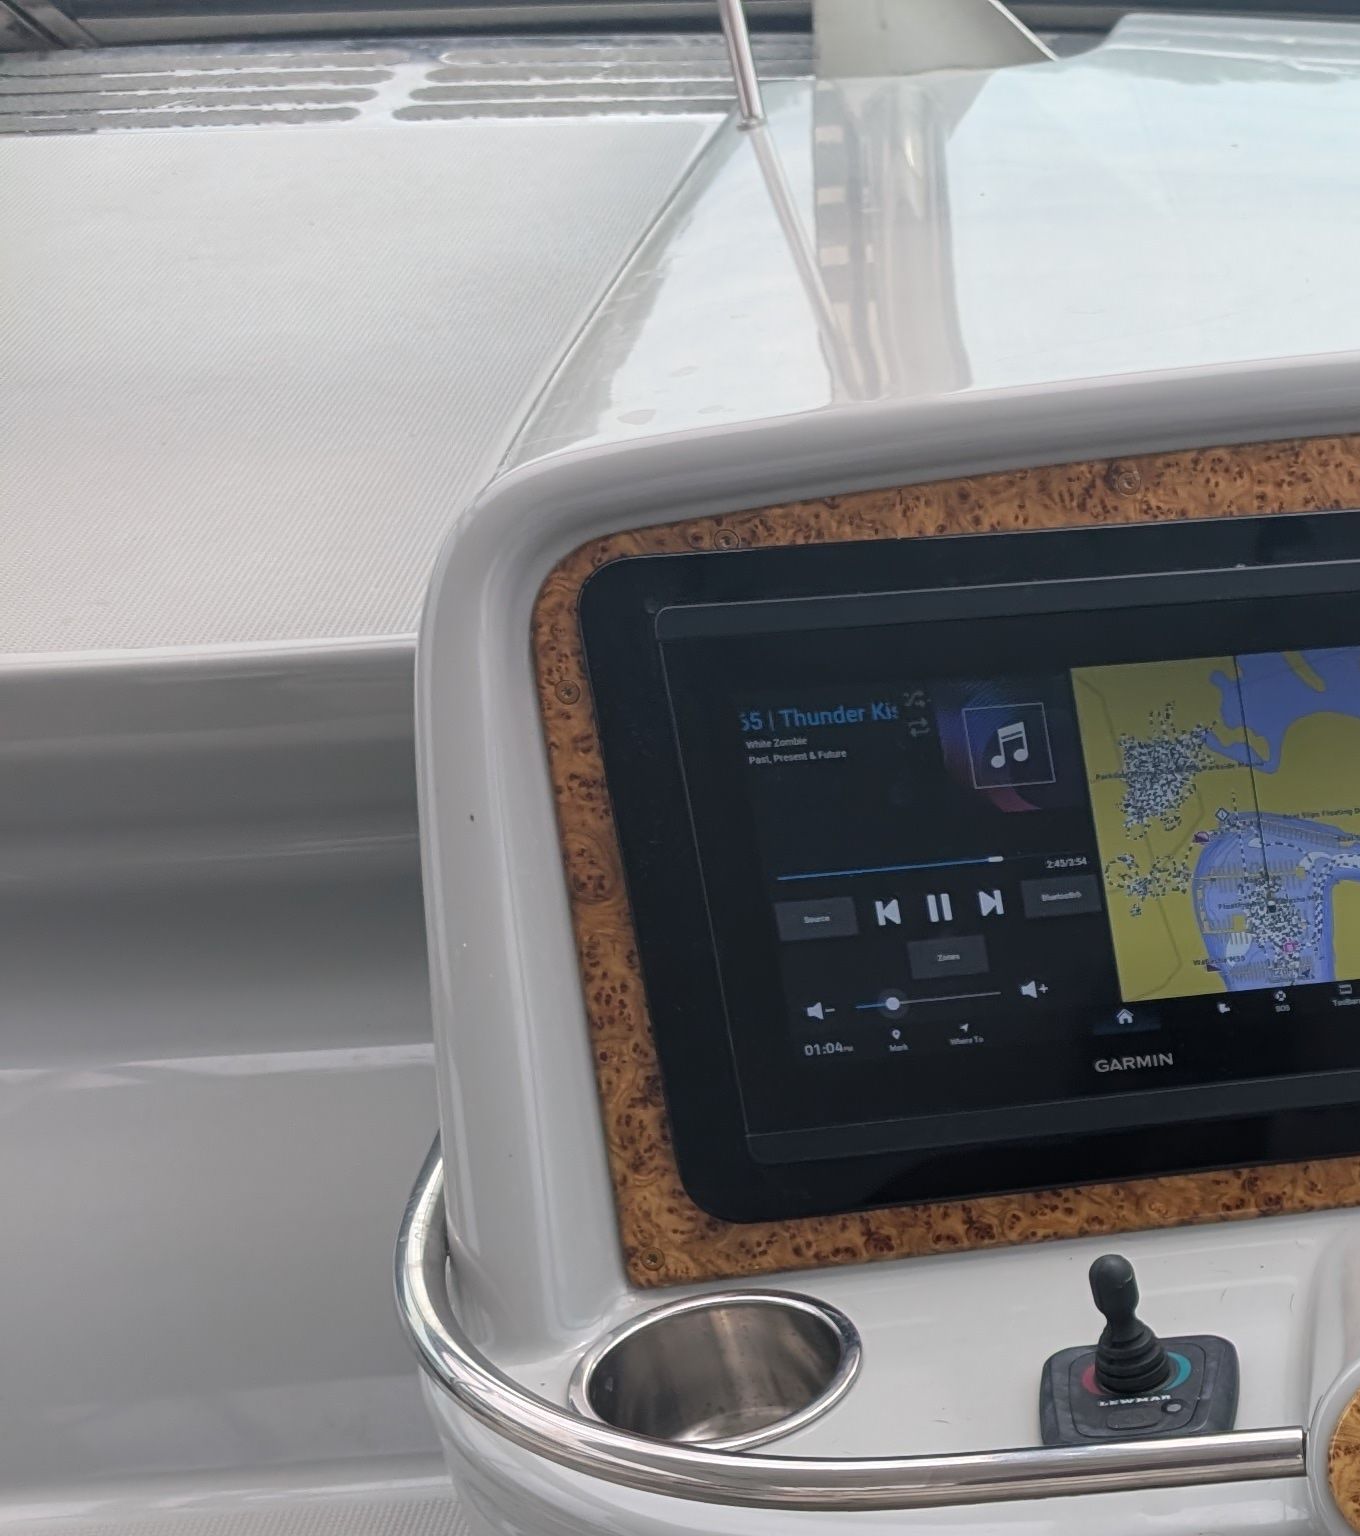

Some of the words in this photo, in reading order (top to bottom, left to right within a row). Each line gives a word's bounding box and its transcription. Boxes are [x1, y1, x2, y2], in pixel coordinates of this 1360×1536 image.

[778, 705, 867, 728] Thunder
[745, 739, 772, 750] White
[773, 737, 808, 748] Zombie
[773, 753, 808, 763] Present
[804, 1040, 843, 1056] 01:04
[1094, 1052, 1174, 1074] GARMIN
[1099, 1394, 1171, 1407] LEWMAR
